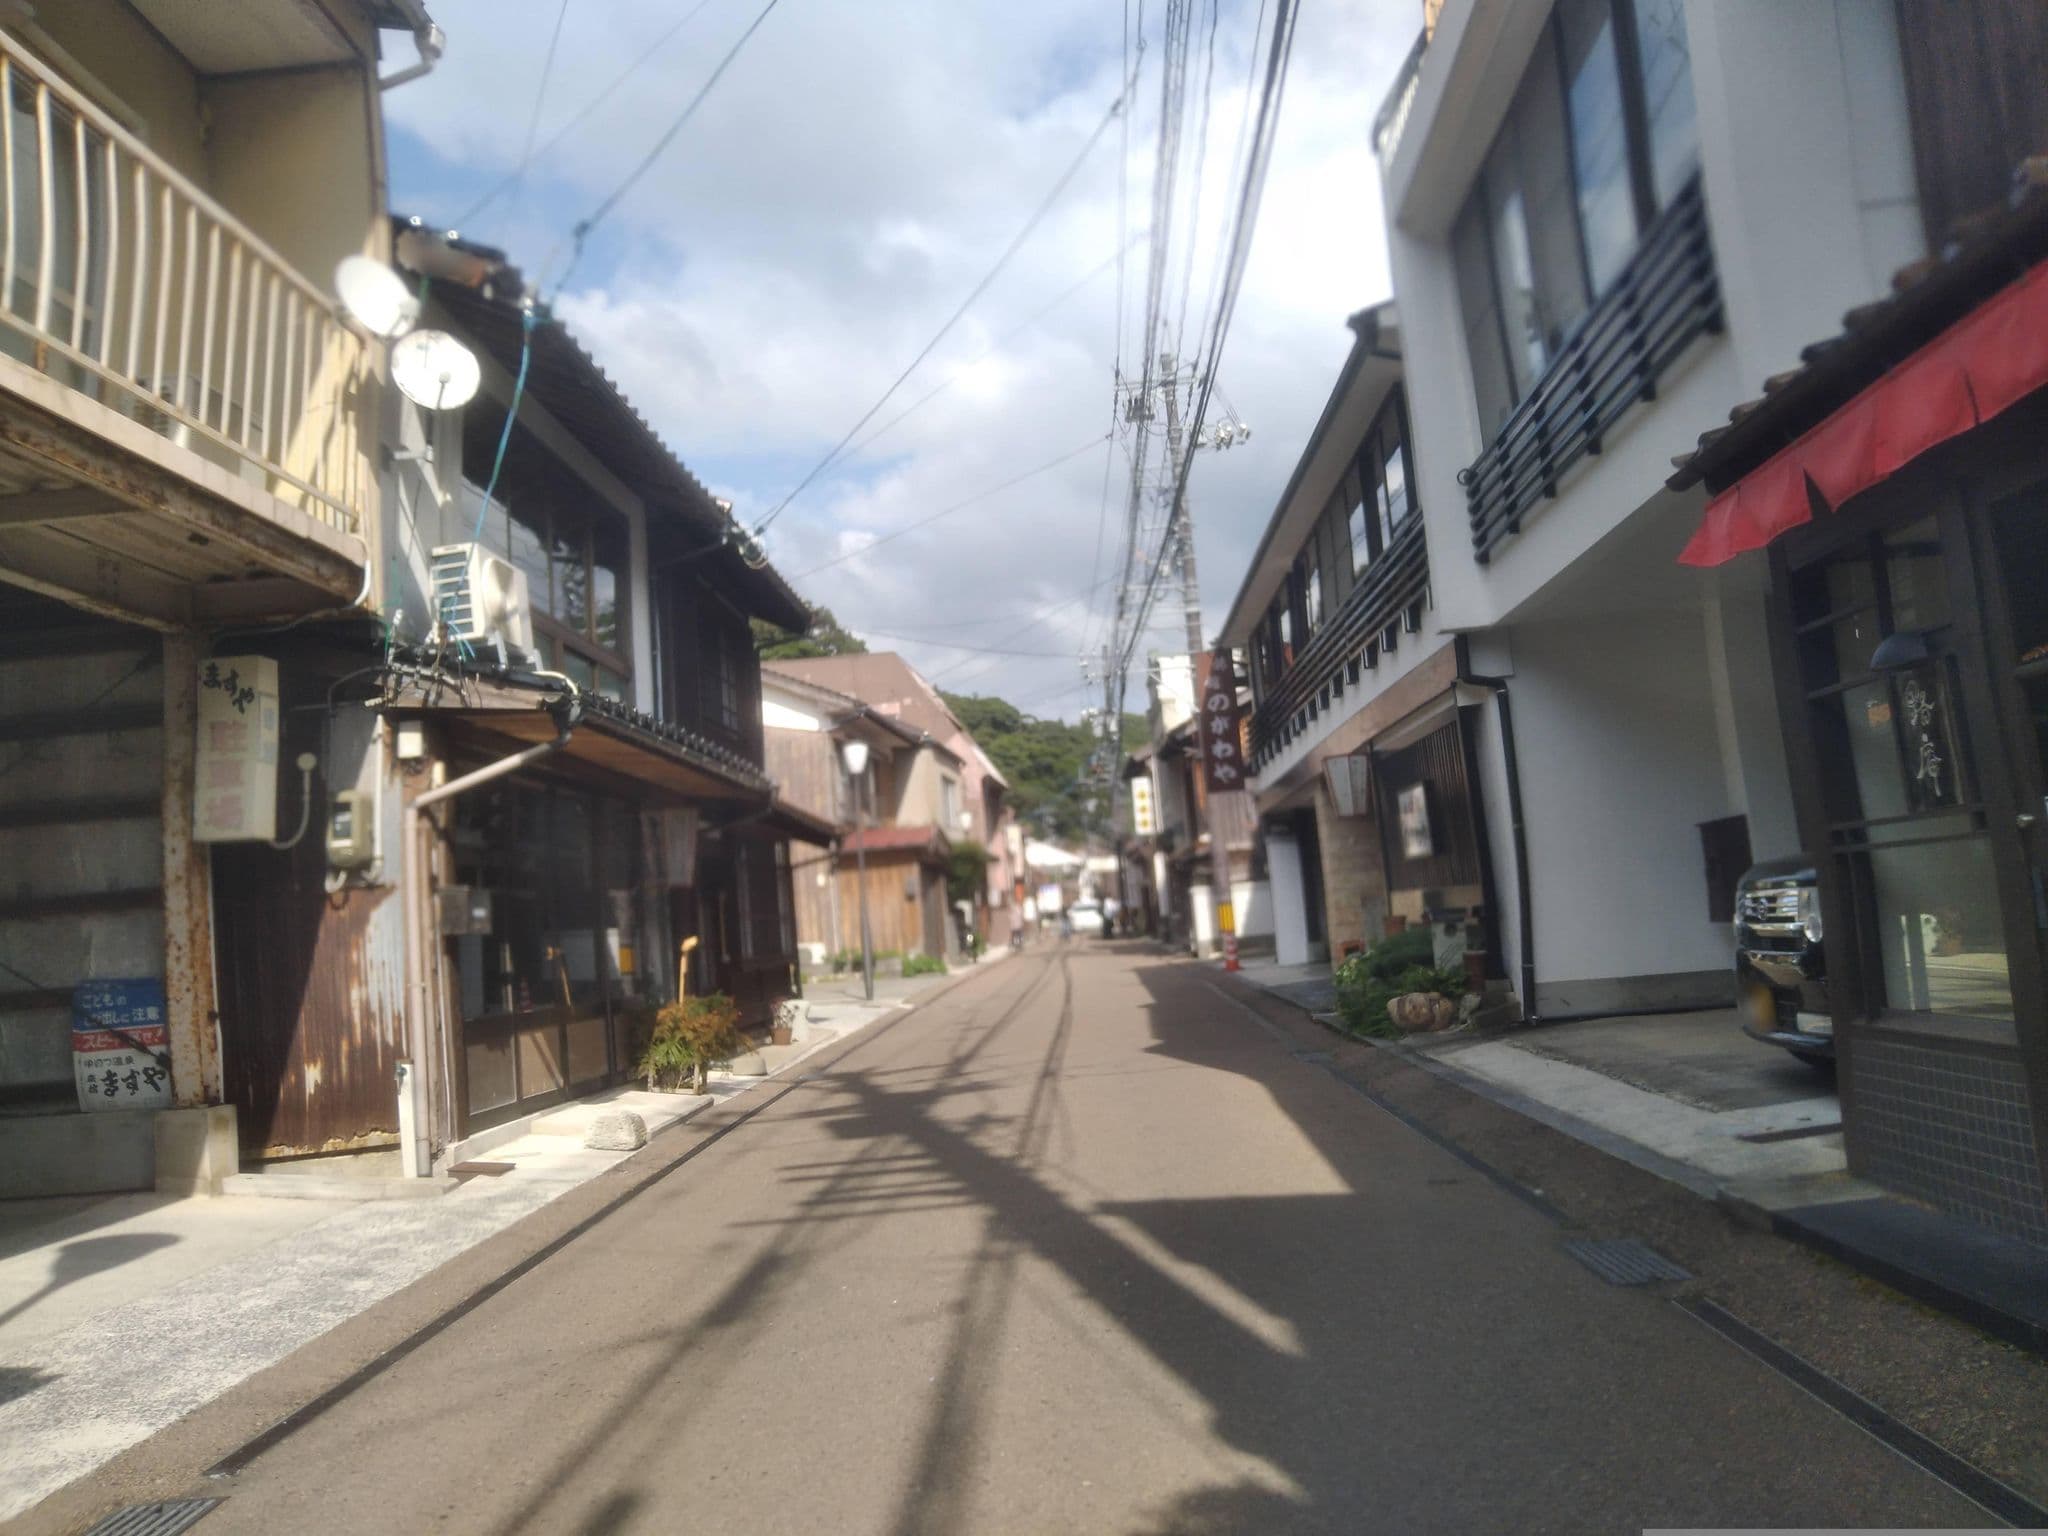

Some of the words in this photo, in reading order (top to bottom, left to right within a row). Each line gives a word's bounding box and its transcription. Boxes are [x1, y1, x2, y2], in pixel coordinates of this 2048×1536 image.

[203, 662, 255, 715] ますや
[1207, 692, 1237, 784] のがわや
[101, 1067, 167, 1098] ますや
